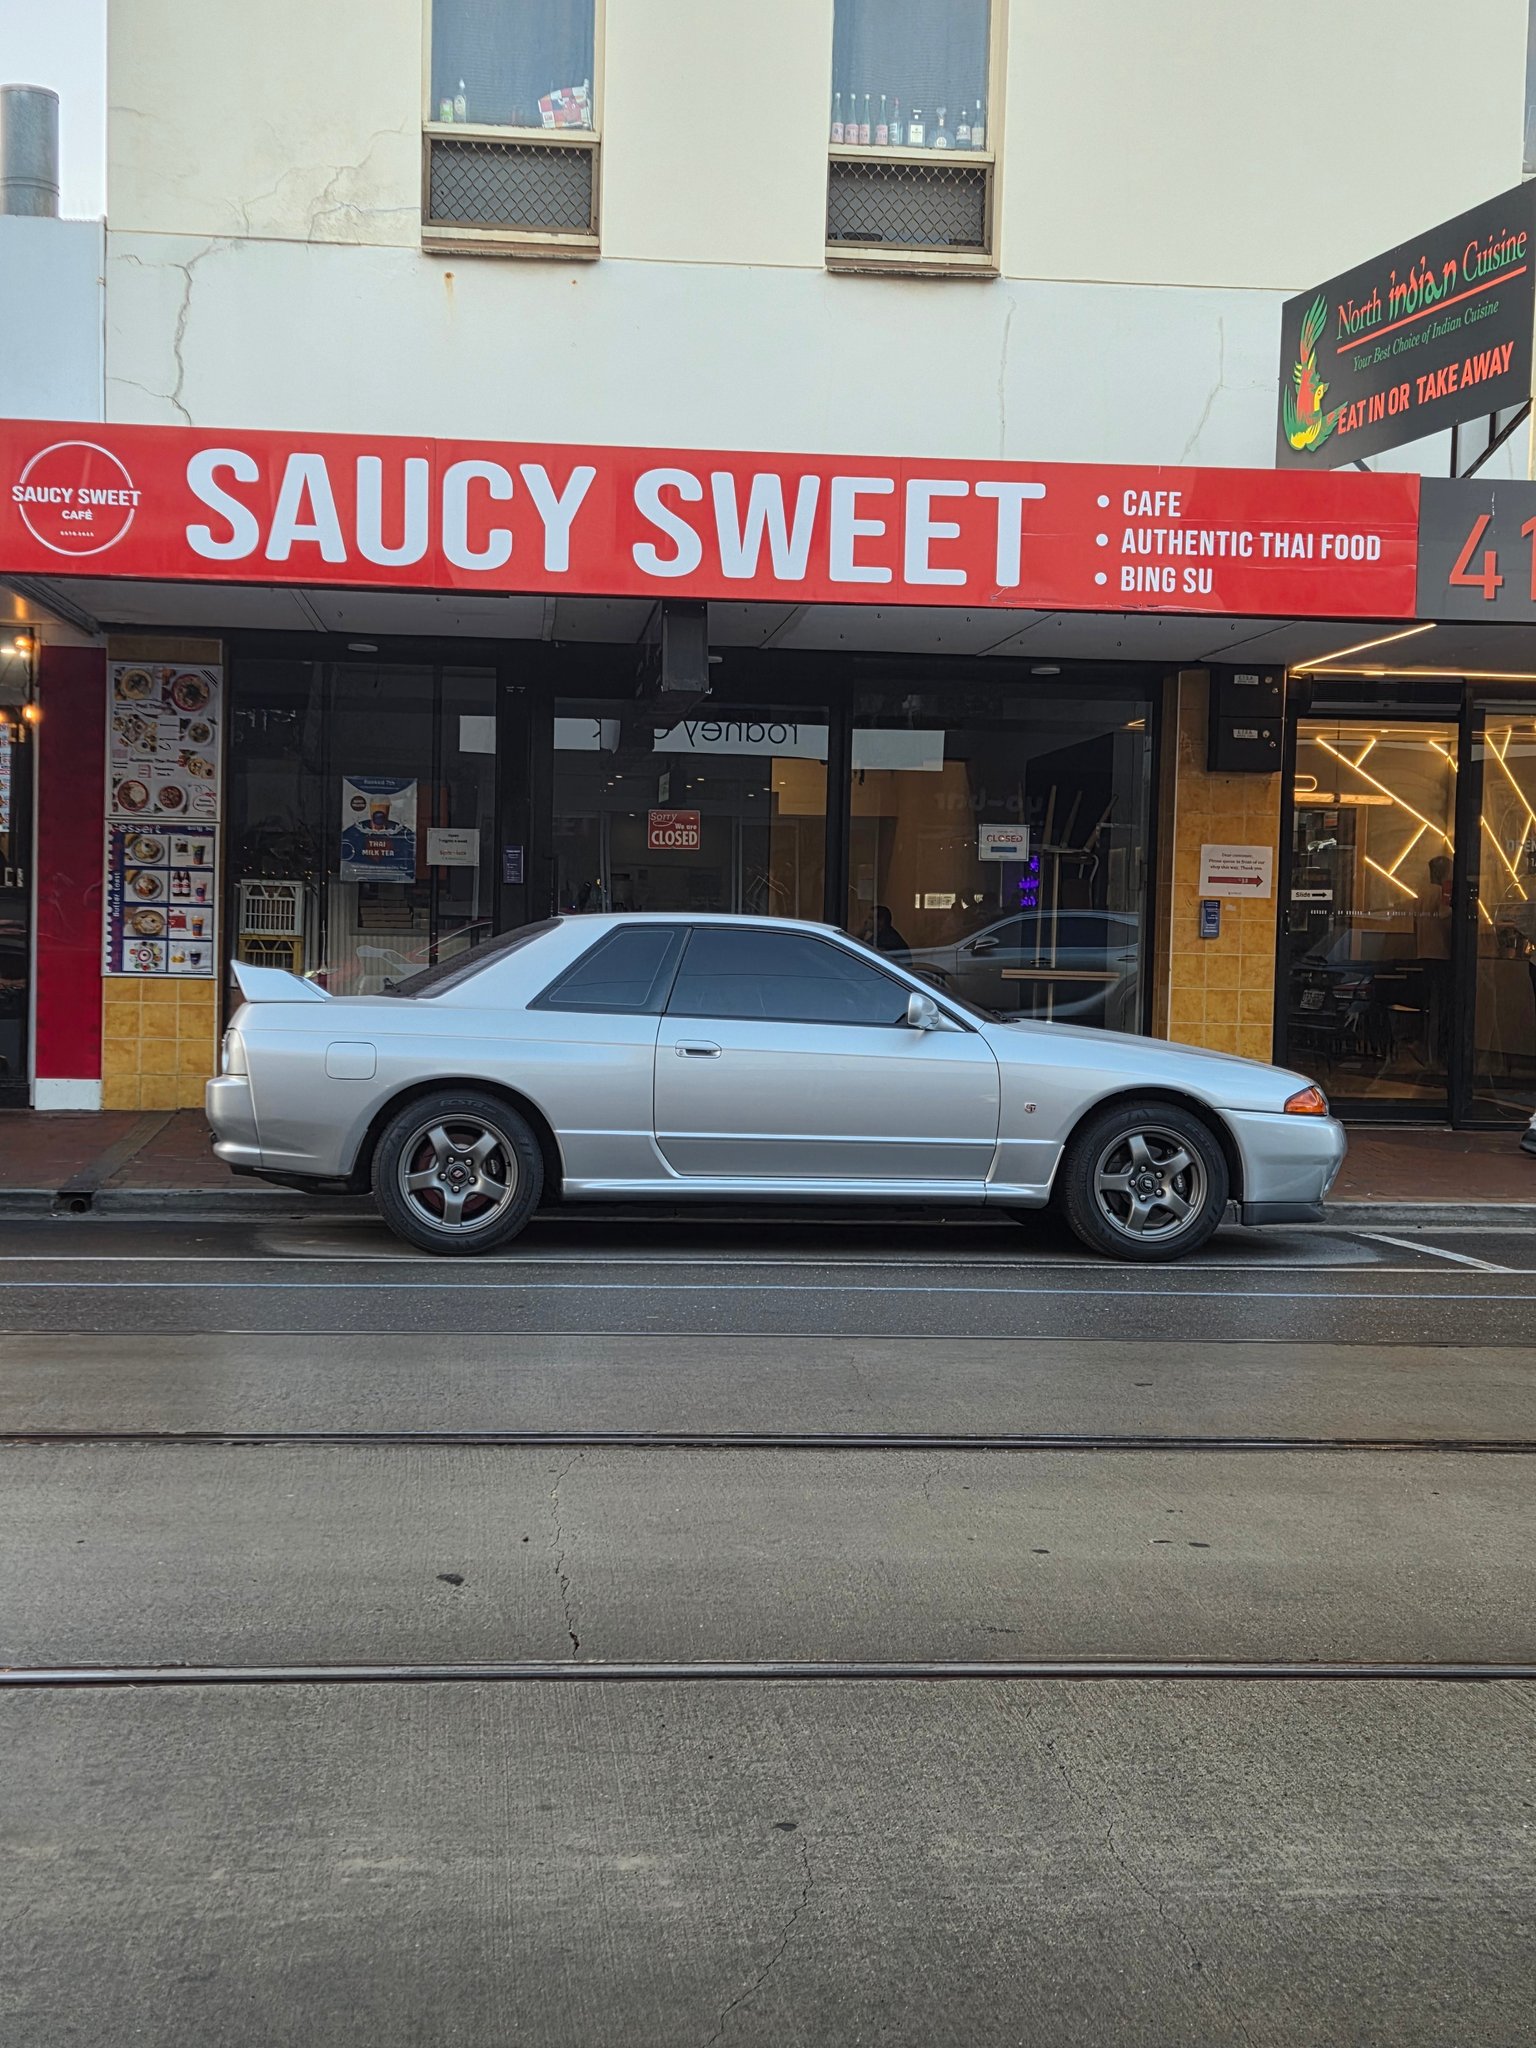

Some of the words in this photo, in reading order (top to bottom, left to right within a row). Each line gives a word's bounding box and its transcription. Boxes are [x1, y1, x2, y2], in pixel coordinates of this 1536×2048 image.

[1336, 287, 1383, 340] North
[1462, 228, 1528, 282] Cuisine
[1353, 354, 1373, 372] Your
[1373, 343, 1392, 365] Best
[1392, 333, 1421, 355] Choice
[1421, 326, 1432, 344] of
[1431, 317, 1462, 339] Indian
[1464, 300, 1500, 325] Cuisine
[1338, 400, 1365, 435] EAT
[1367, 391, 1385, 424] IN
[1388, 382, 1411, 417] OR
[1416, 362, 1459, 406] TAKE
[1460, 341, 1514, 390] AWAY
[12, 485, 74, 504] SAUCY
[77, 488, 142, 507] SWEET
[1122, 489, 1182, 517] CAFE
[185, 448, 597, 573] SAUCY
[632, 467, 1047, 588] SWEET
[1121, 528, 1253, 557] AUTHENTIC
[1259, 531, 1314, 559] THAI
[1321, 534, 1382, 561] FOOD
[1120, 566, 1176, 592] BING
[1183, 567, 1213, 594] SU
[651, 812, 678, 827] Sorry
[651, 830, 698, 845] CLOSED
[987, 834, 1023, 843] CLOSED
